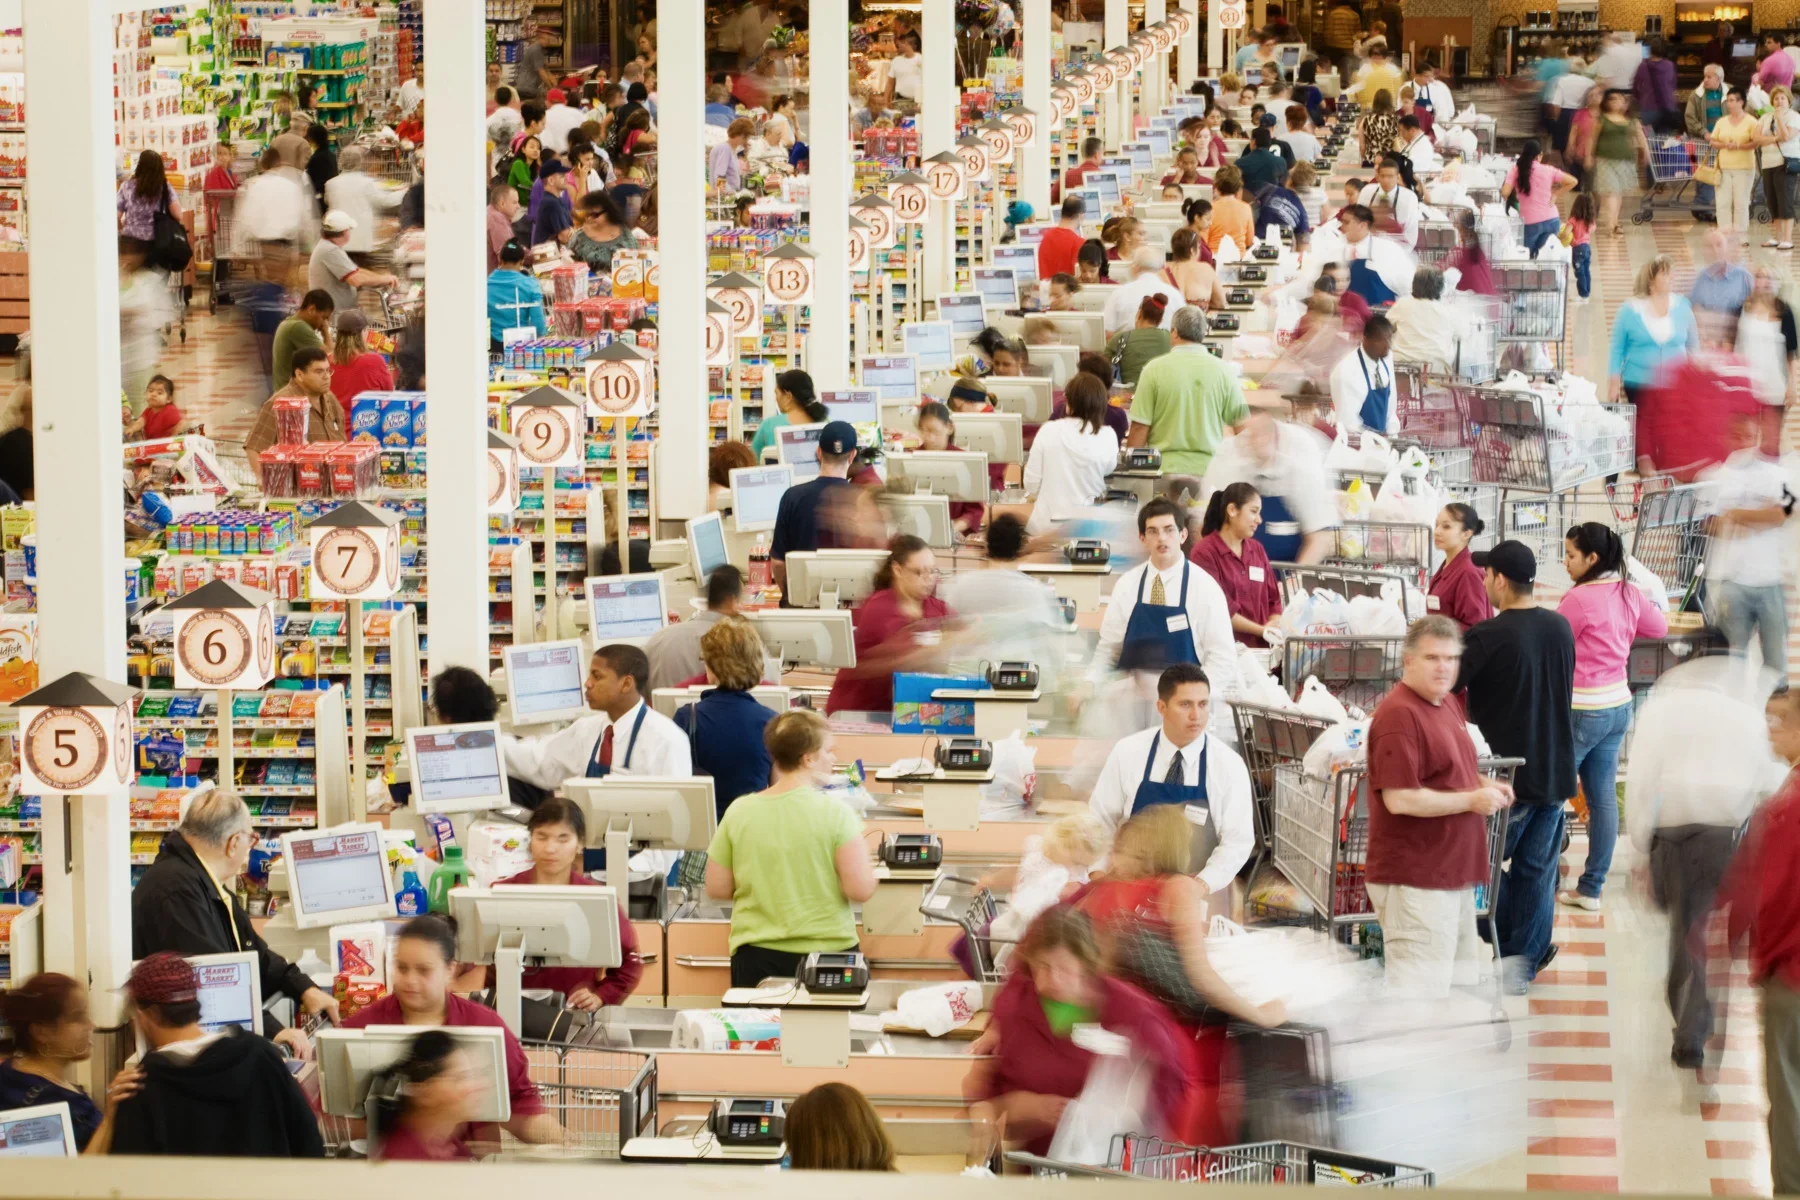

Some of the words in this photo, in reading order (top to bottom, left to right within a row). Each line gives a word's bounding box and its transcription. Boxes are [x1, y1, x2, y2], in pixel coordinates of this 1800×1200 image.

[934, 172, 953, 190] 17
[898, 194, 920, 212] 16
[776, 270, 800, 290] 13
[600, 376, 630, 400] 10
[534, 422, 552, 450] 9
[338, 546, 358, 578] 7
[203, 628, 227, 665] 6
[28, 715, 46, 737] Quality
[74, 711, 91, 722] Since
[91, 721, 103, 738] 1917
[53, 730, 78, 768] 5
[37, 772, 52, 785] More
[79, 772, 97, 786] Dollar
[204, 967, 236, 975] MARKET
